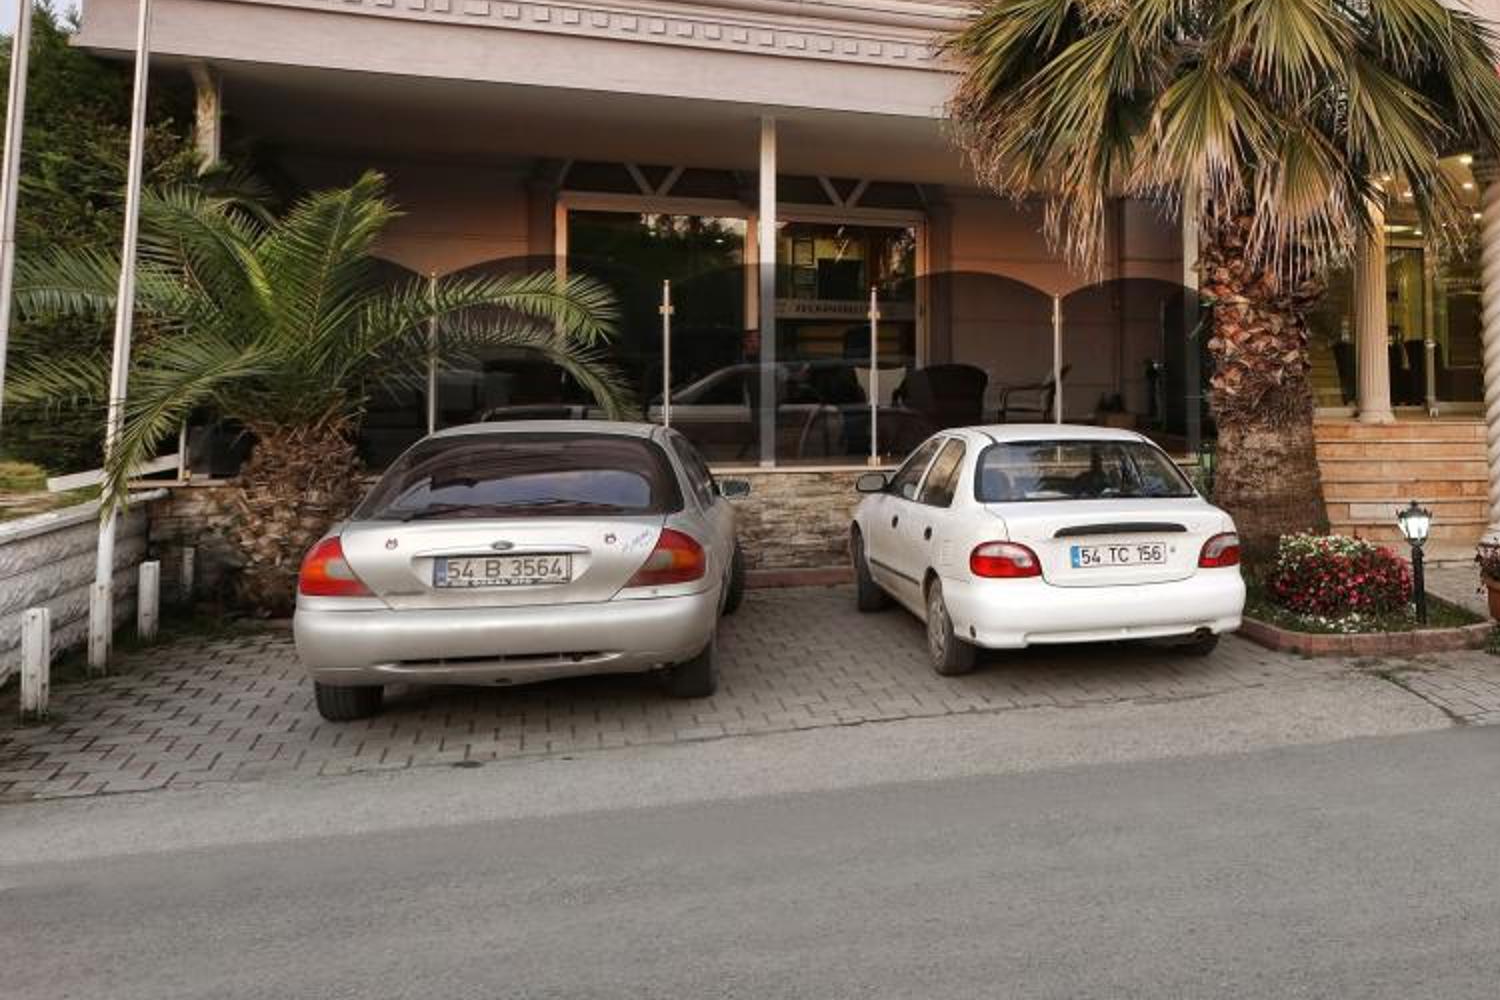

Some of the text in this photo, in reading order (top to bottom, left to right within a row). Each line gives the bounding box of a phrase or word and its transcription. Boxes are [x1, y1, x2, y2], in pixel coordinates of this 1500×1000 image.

[1081, 545, 1161, 565] 54 TC 156
[448, 557, 562, 579] 54 B 3564
